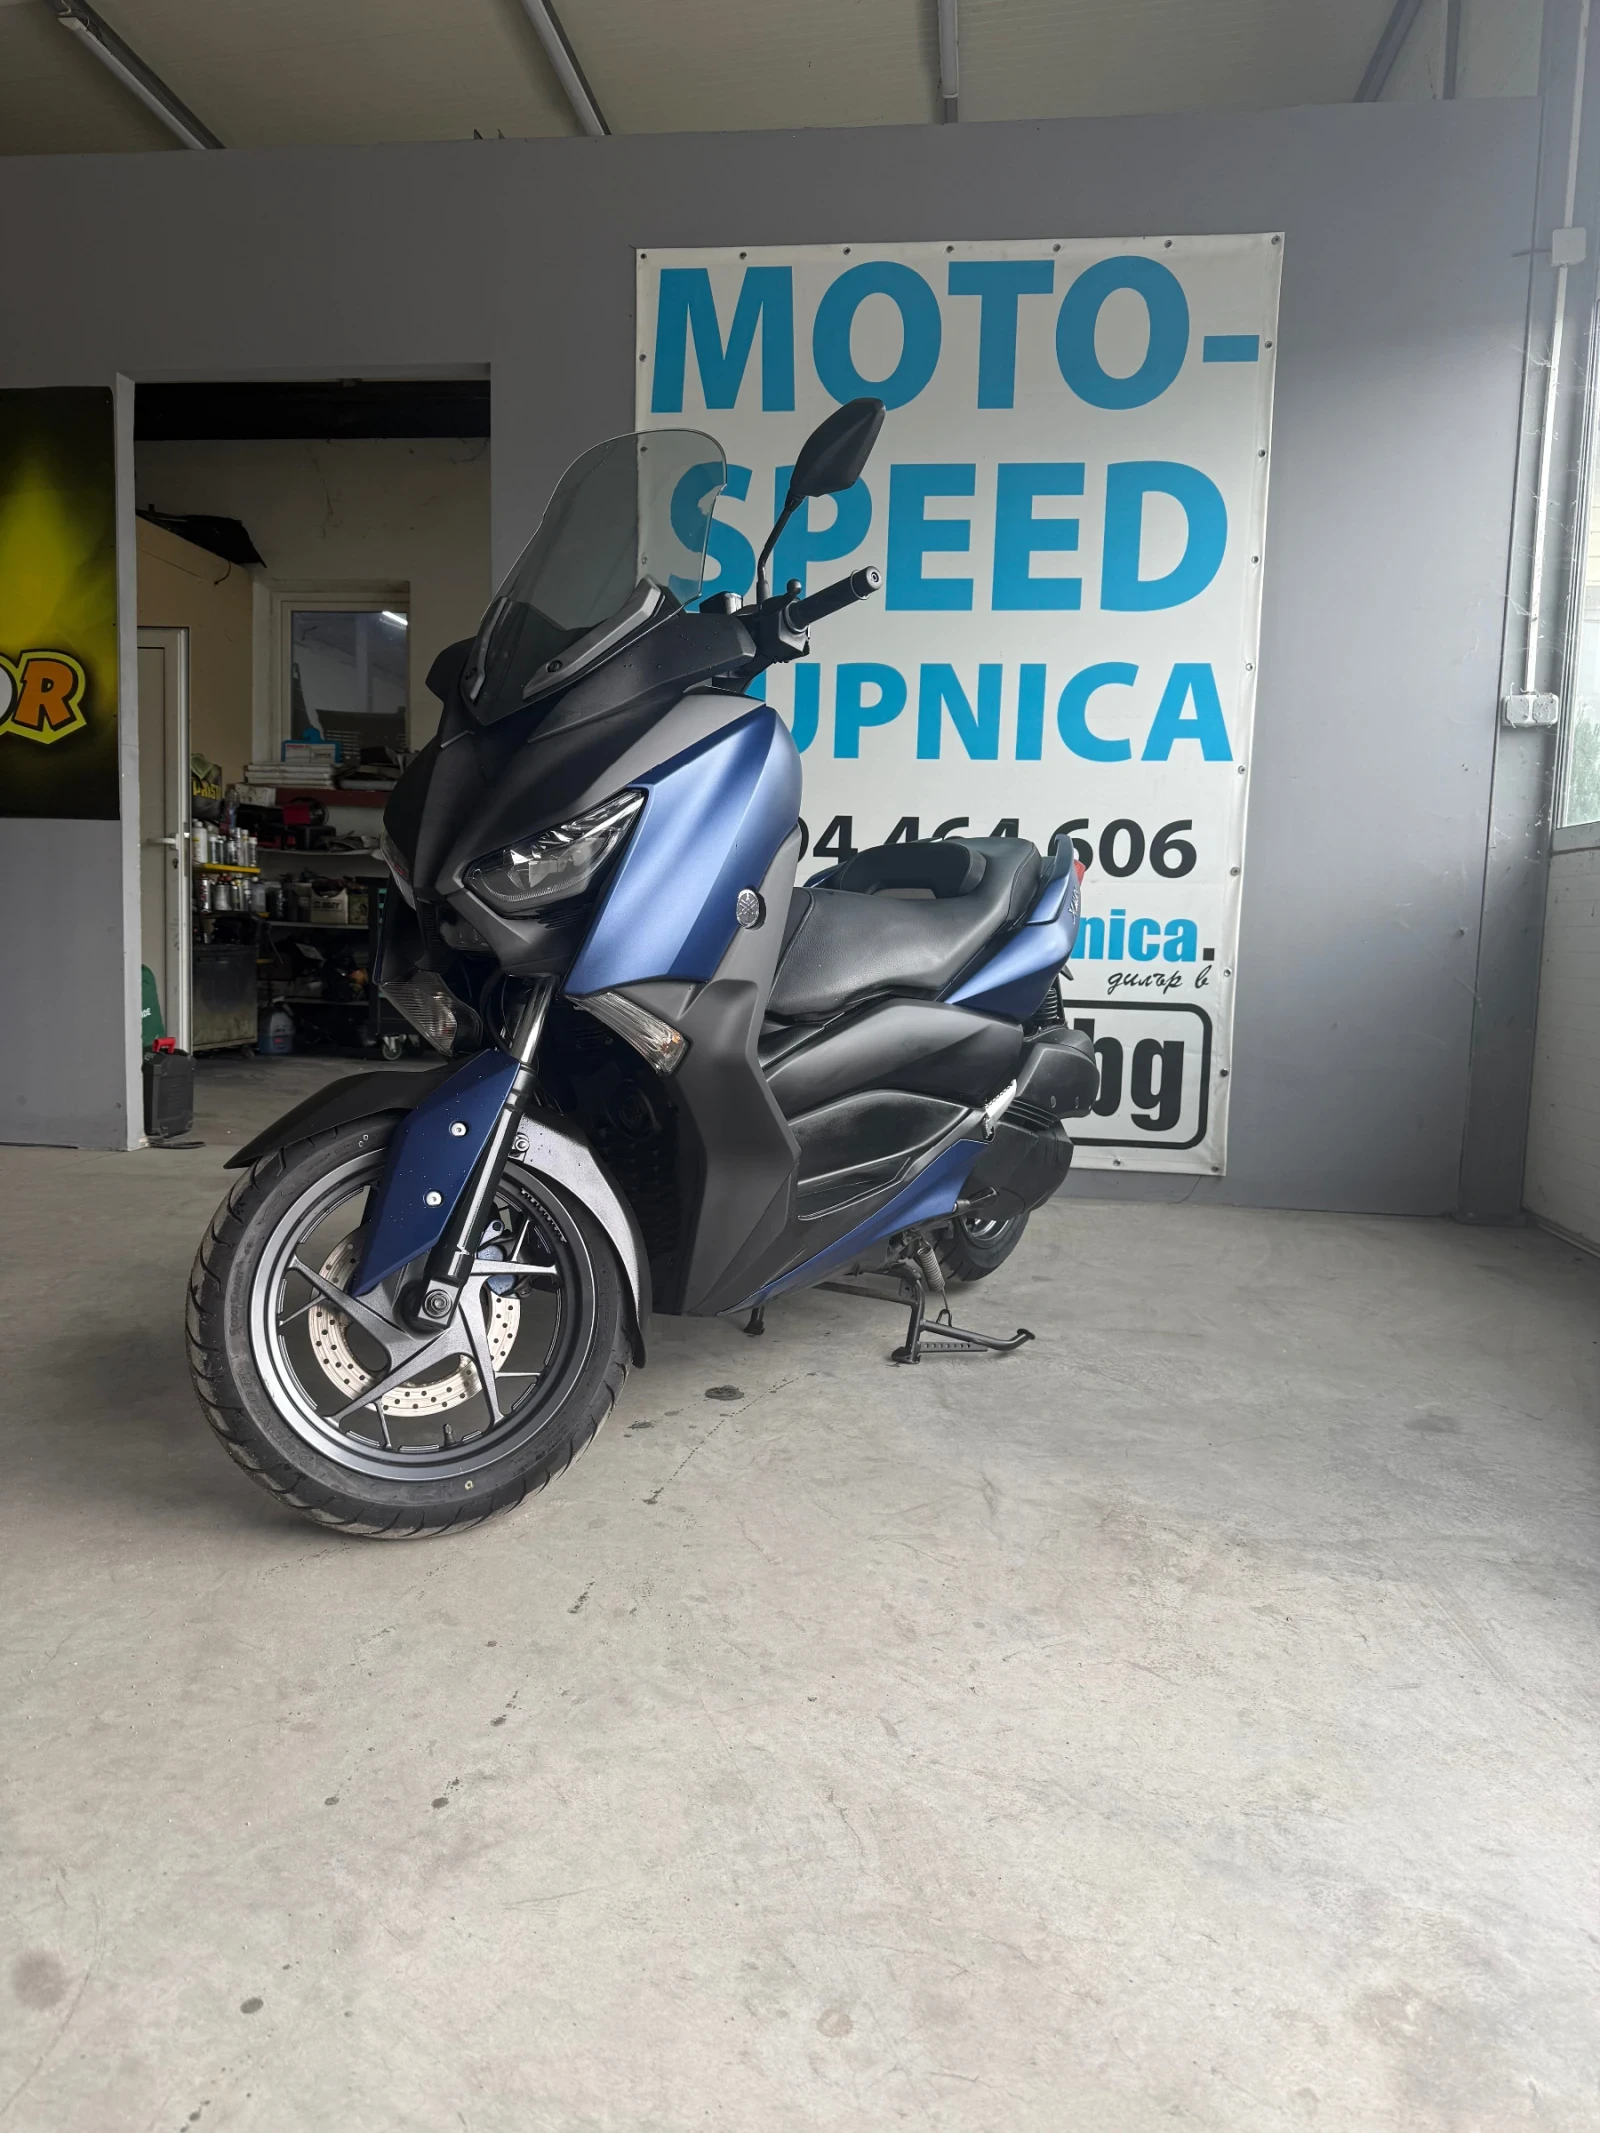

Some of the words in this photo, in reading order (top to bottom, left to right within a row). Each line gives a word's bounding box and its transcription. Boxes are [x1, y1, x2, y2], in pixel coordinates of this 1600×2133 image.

[650, 255, 1260, 413] MOTO-
[668, 460, 1228, 613] SPEED
[1107, 970, 1183, 995] дилър
[1195, 965, 1213, 989] в
